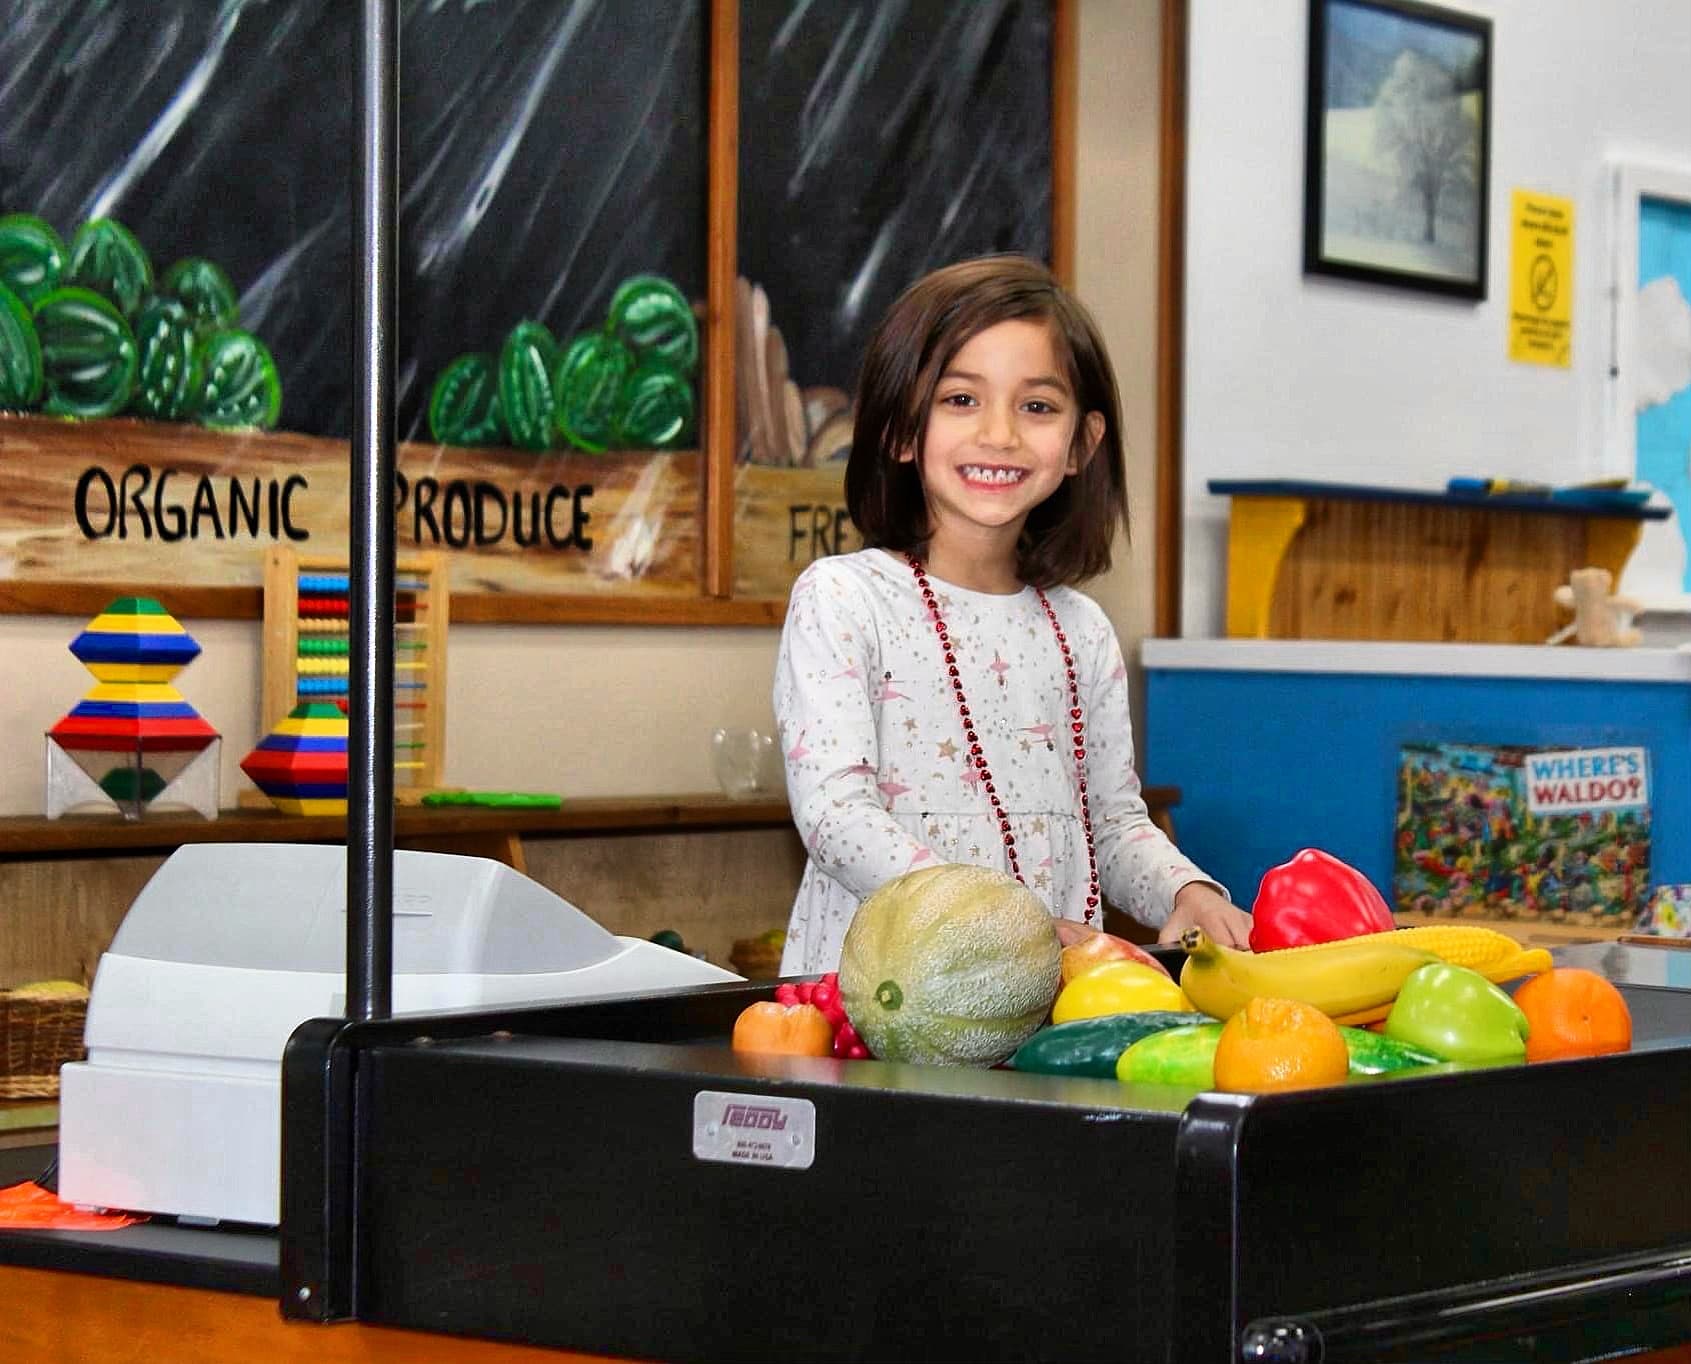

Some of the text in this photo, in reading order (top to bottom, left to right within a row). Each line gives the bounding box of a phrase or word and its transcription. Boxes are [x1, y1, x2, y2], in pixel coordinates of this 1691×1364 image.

[75, 463, 310, 542] ORGANIC
[789, 504, 850, 561] FRE
[1532, 752, 1639, 780] WHERE'S
[1533, 777, 1641, 804] WALDO?
